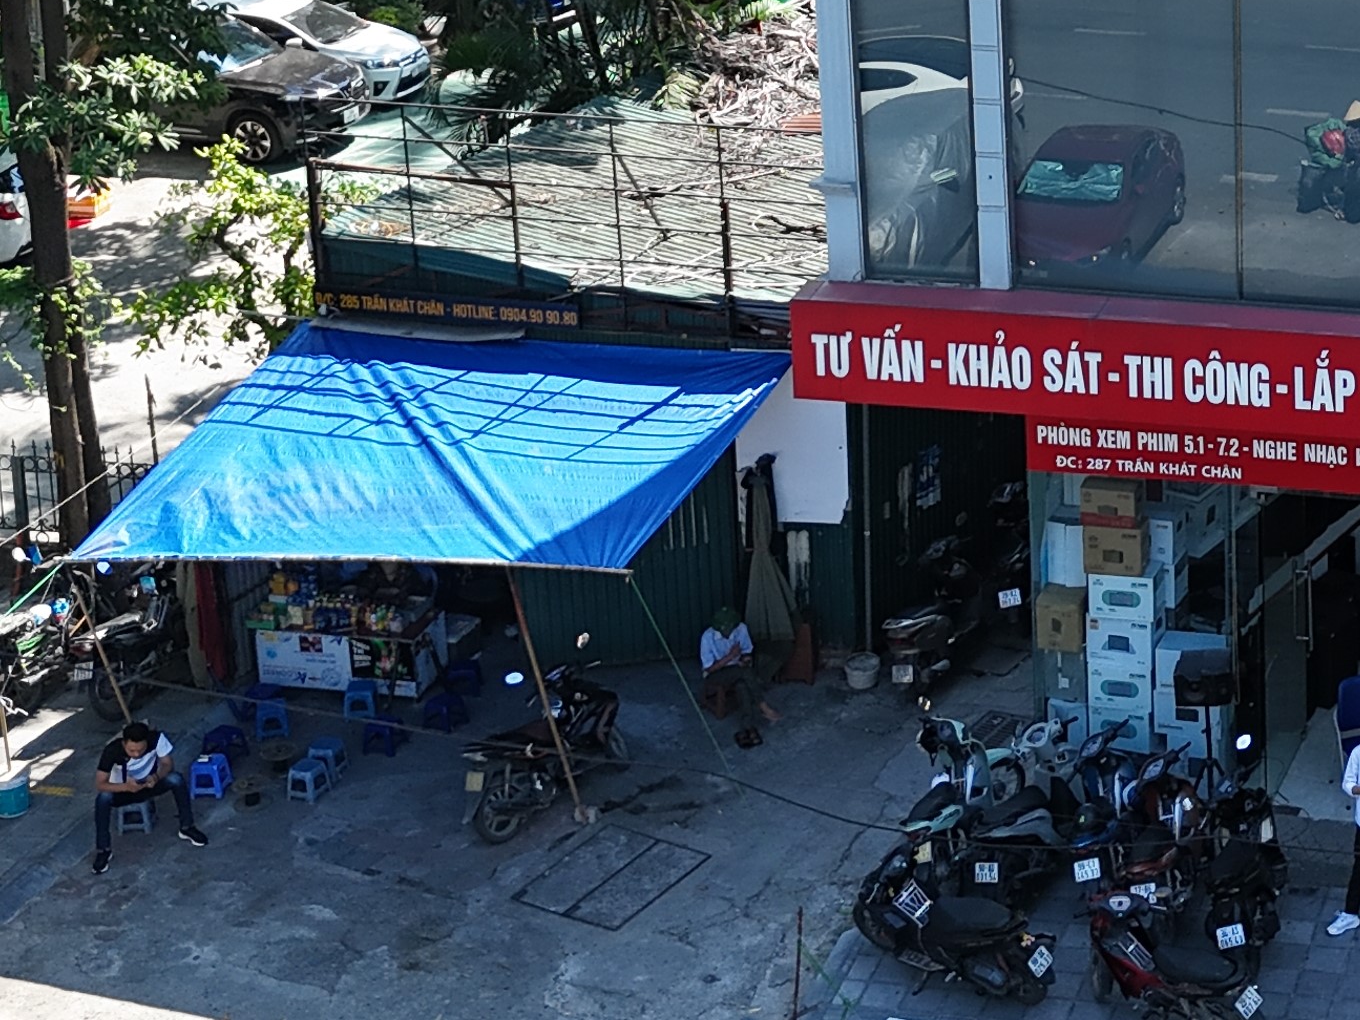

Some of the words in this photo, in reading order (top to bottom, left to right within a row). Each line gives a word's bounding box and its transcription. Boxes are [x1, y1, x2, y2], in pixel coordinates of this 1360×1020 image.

[340, 293, 359, 309] 285
[811, 331, 852, 378] TƯ
[862, 323, 924, 383] VẤN
[948, 330, 1031, 391] KHẢO
[1042, 341, 1101, 395] SÁT
[1124, 355, 1173, 401] THI
[1184, 349, 1270, 408] CÔNG
[1294, 349, 1355, 414] LẮP
[1037, 421, 1092, 448] PHÒNG
[1097, 429, 1131, 450] XEM
[1137, 431, 1178, 454] PHIM
[1252, 439, 1297, 462] NGHE
[1304, 444, 1348, 470] NHẠC
[1056, 455, 1083, 470] ĐC:
[1086, 458, 1112, 472] 287
[1159, 460, 1197, 477] KHÁT
[1201, 460, 1243, 480] CHÂN
